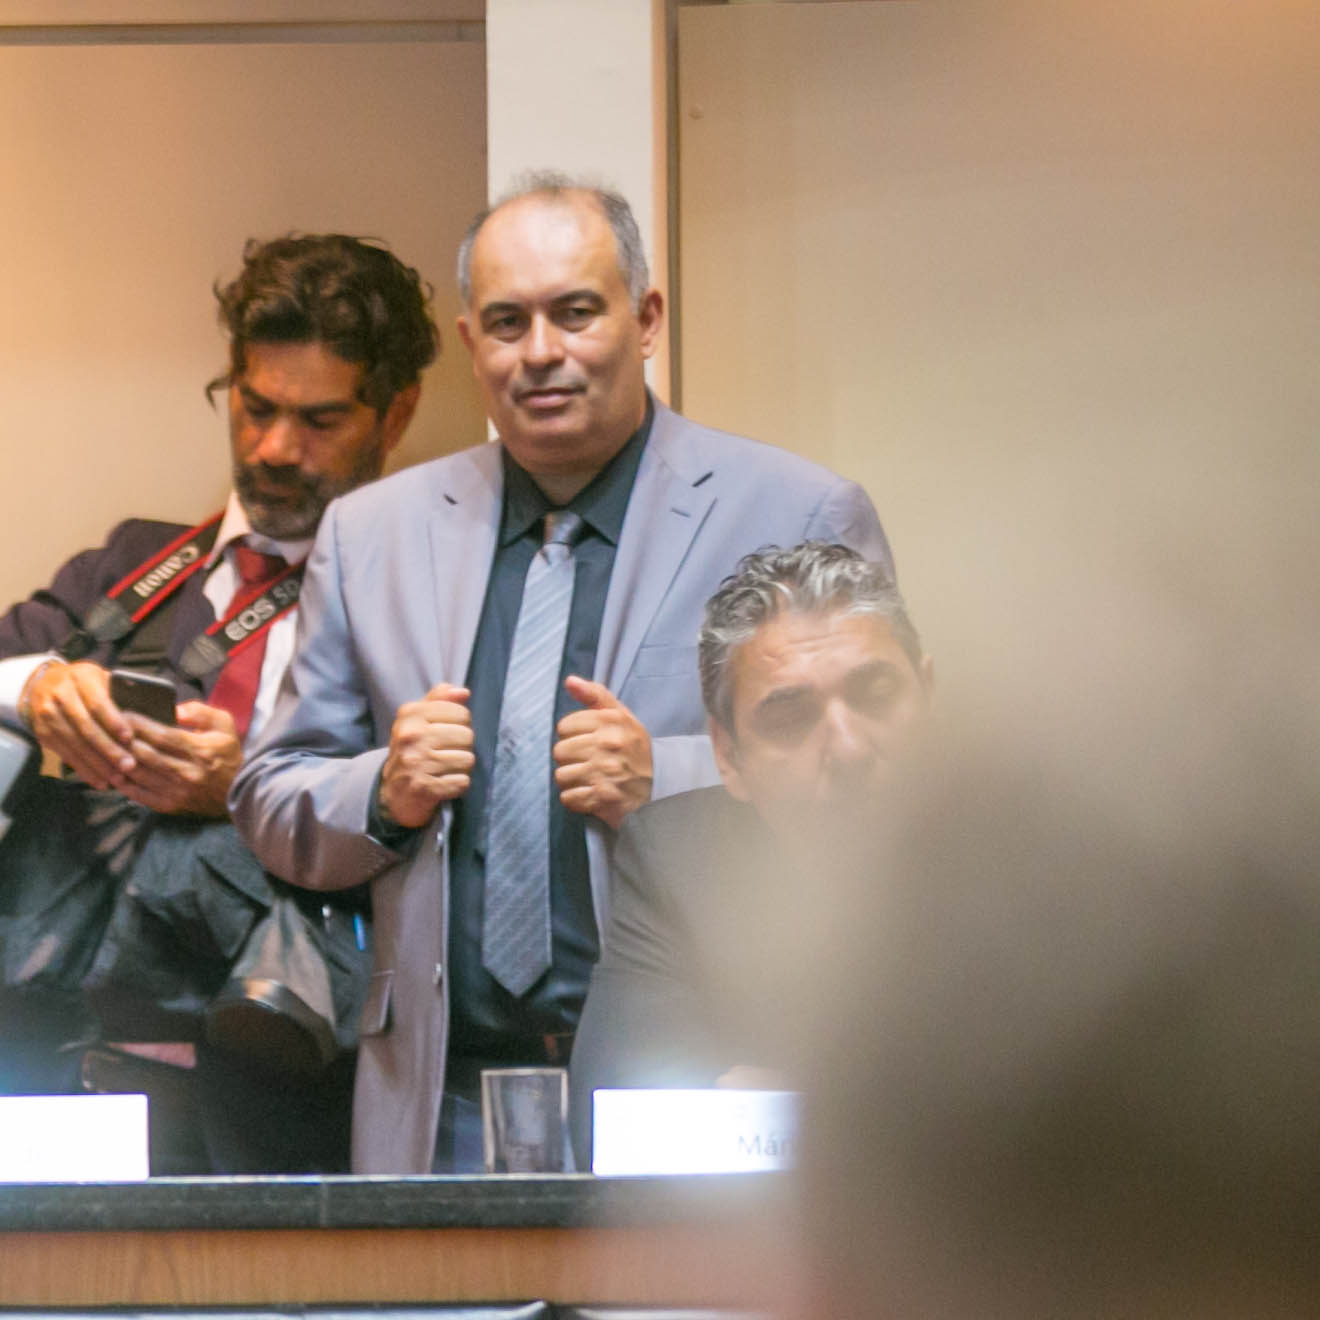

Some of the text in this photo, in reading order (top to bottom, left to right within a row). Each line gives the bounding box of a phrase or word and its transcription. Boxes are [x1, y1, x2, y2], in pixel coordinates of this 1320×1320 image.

[132, 544, 199, 598] Canon
[225, 598, 276, 641] EOS
[737, 1132, 790, 1155] Már
